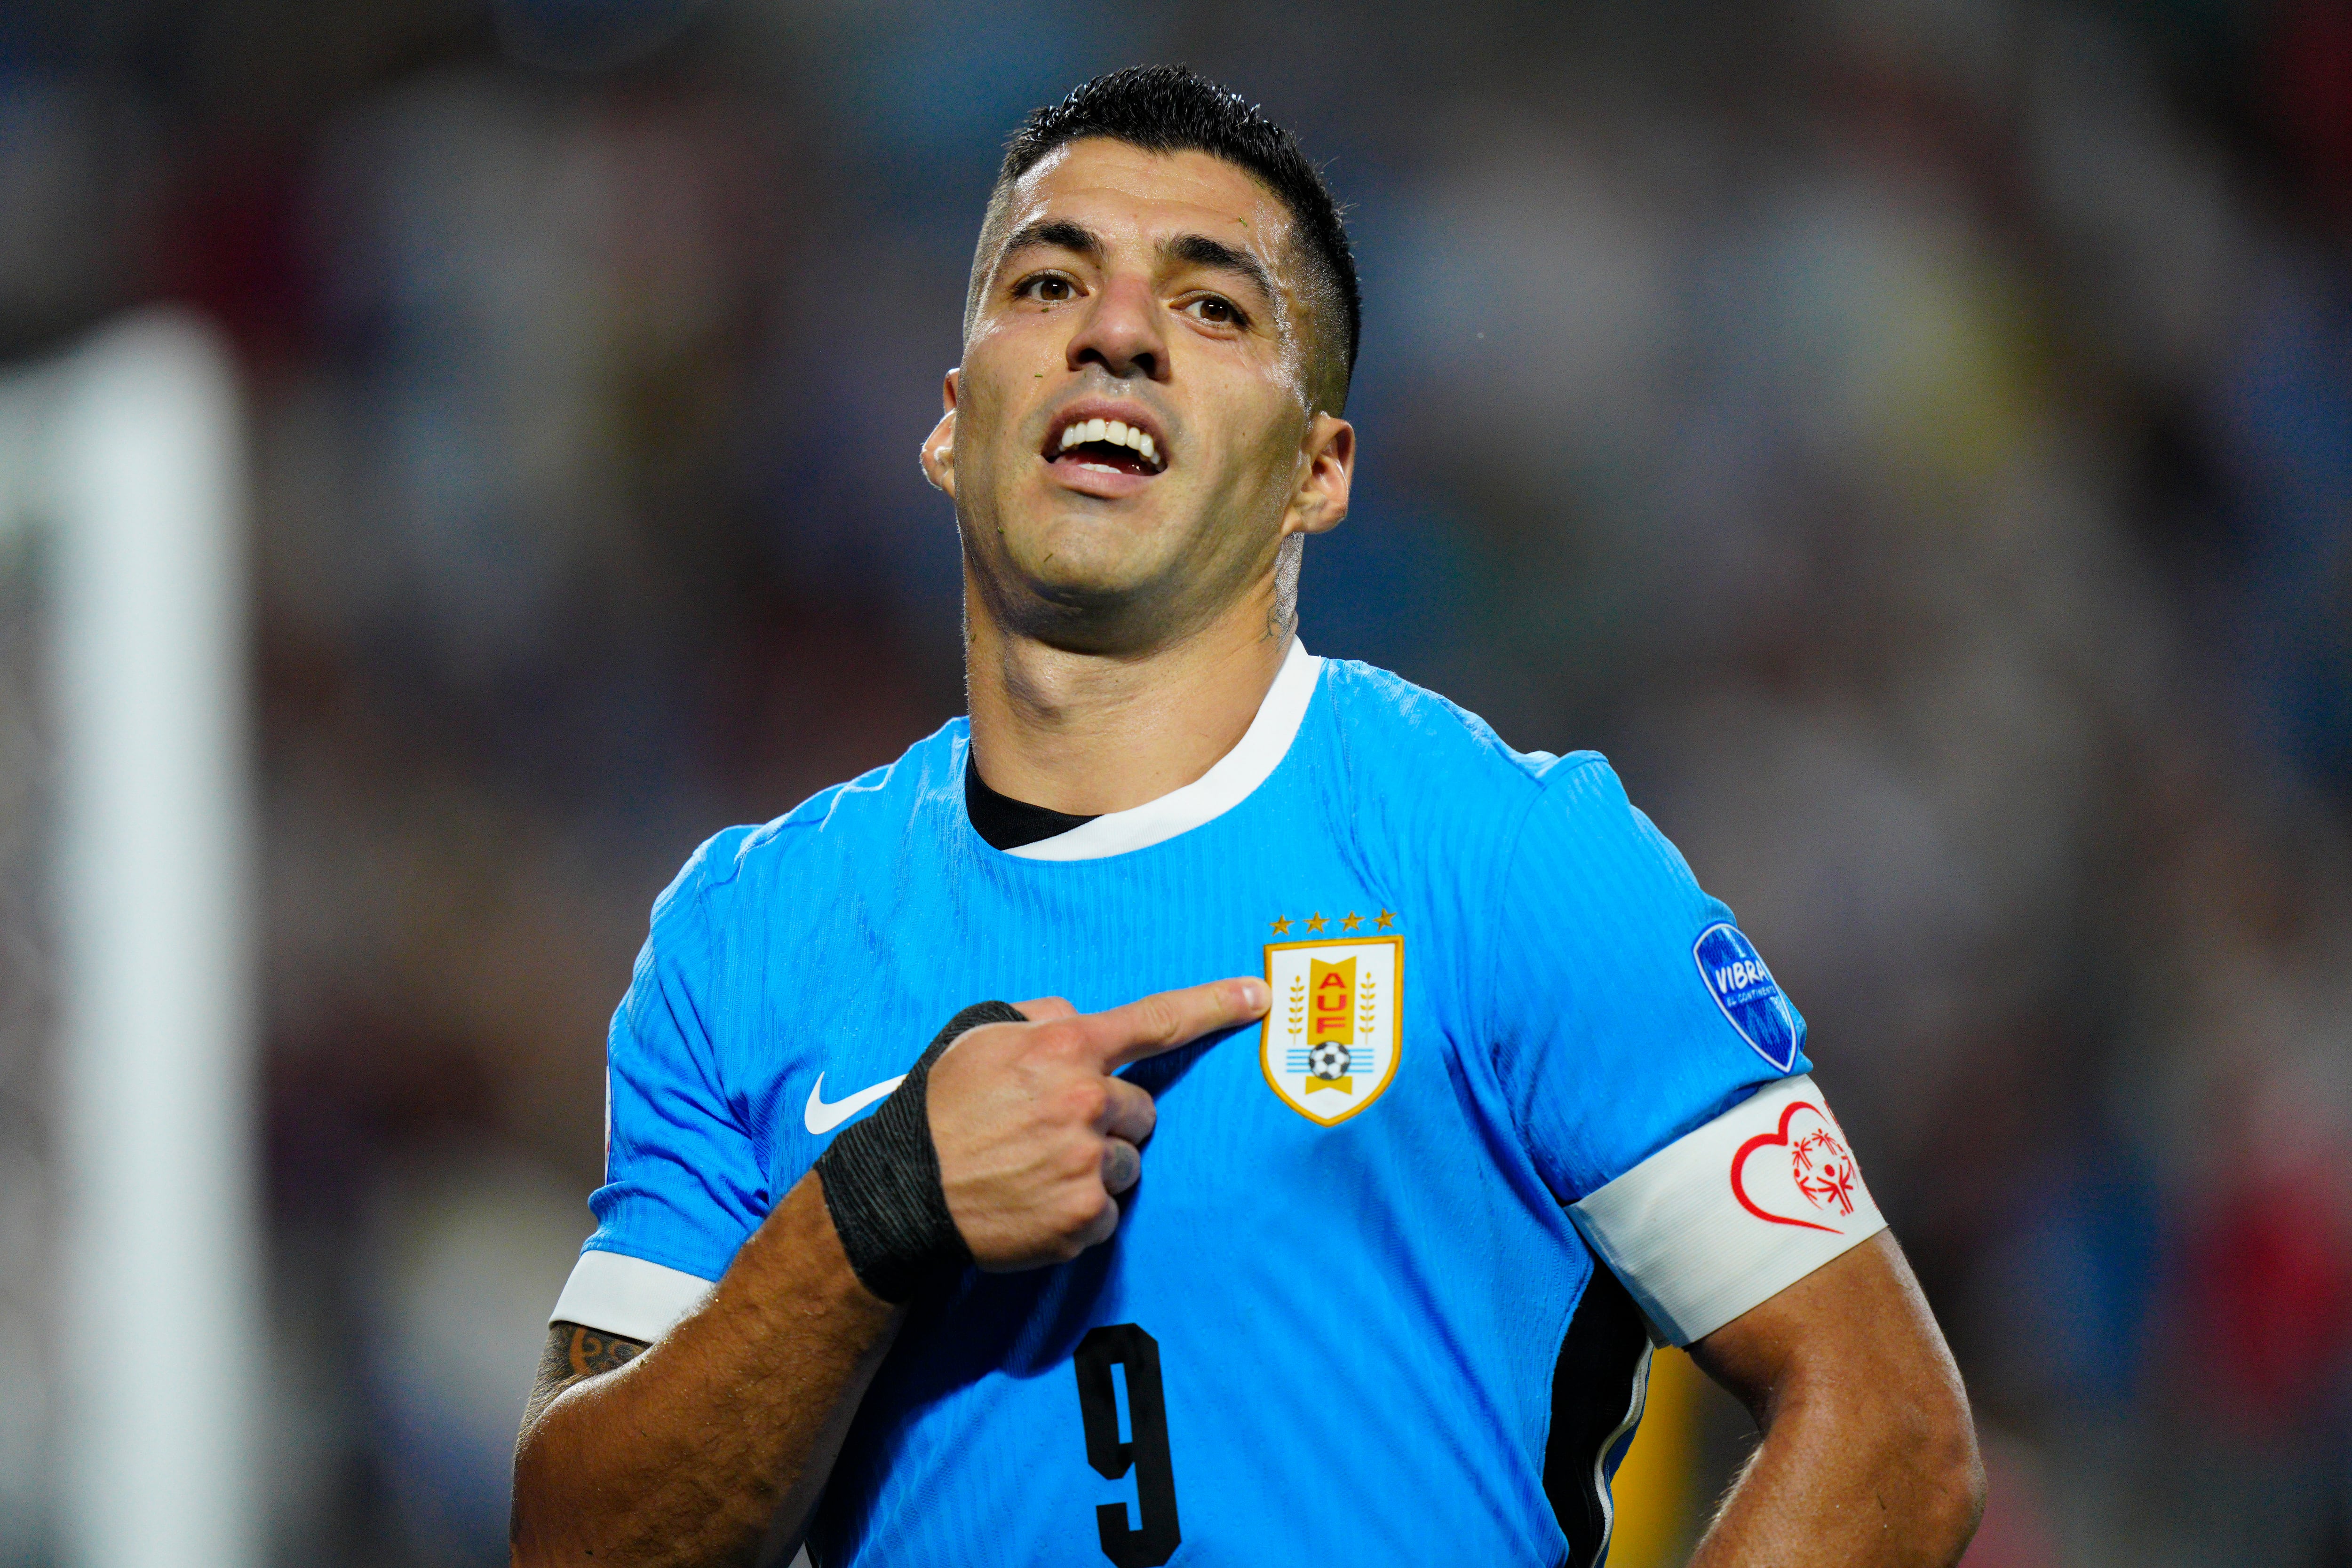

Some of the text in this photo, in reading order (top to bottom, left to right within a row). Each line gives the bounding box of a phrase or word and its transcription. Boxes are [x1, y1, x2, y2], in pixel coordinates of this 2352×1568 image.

[1317, 973, 1347, 1034] AUF
[1715, 960, 1770, 994] VIBRA
[1073, 1323, 1182, 1568] 9
